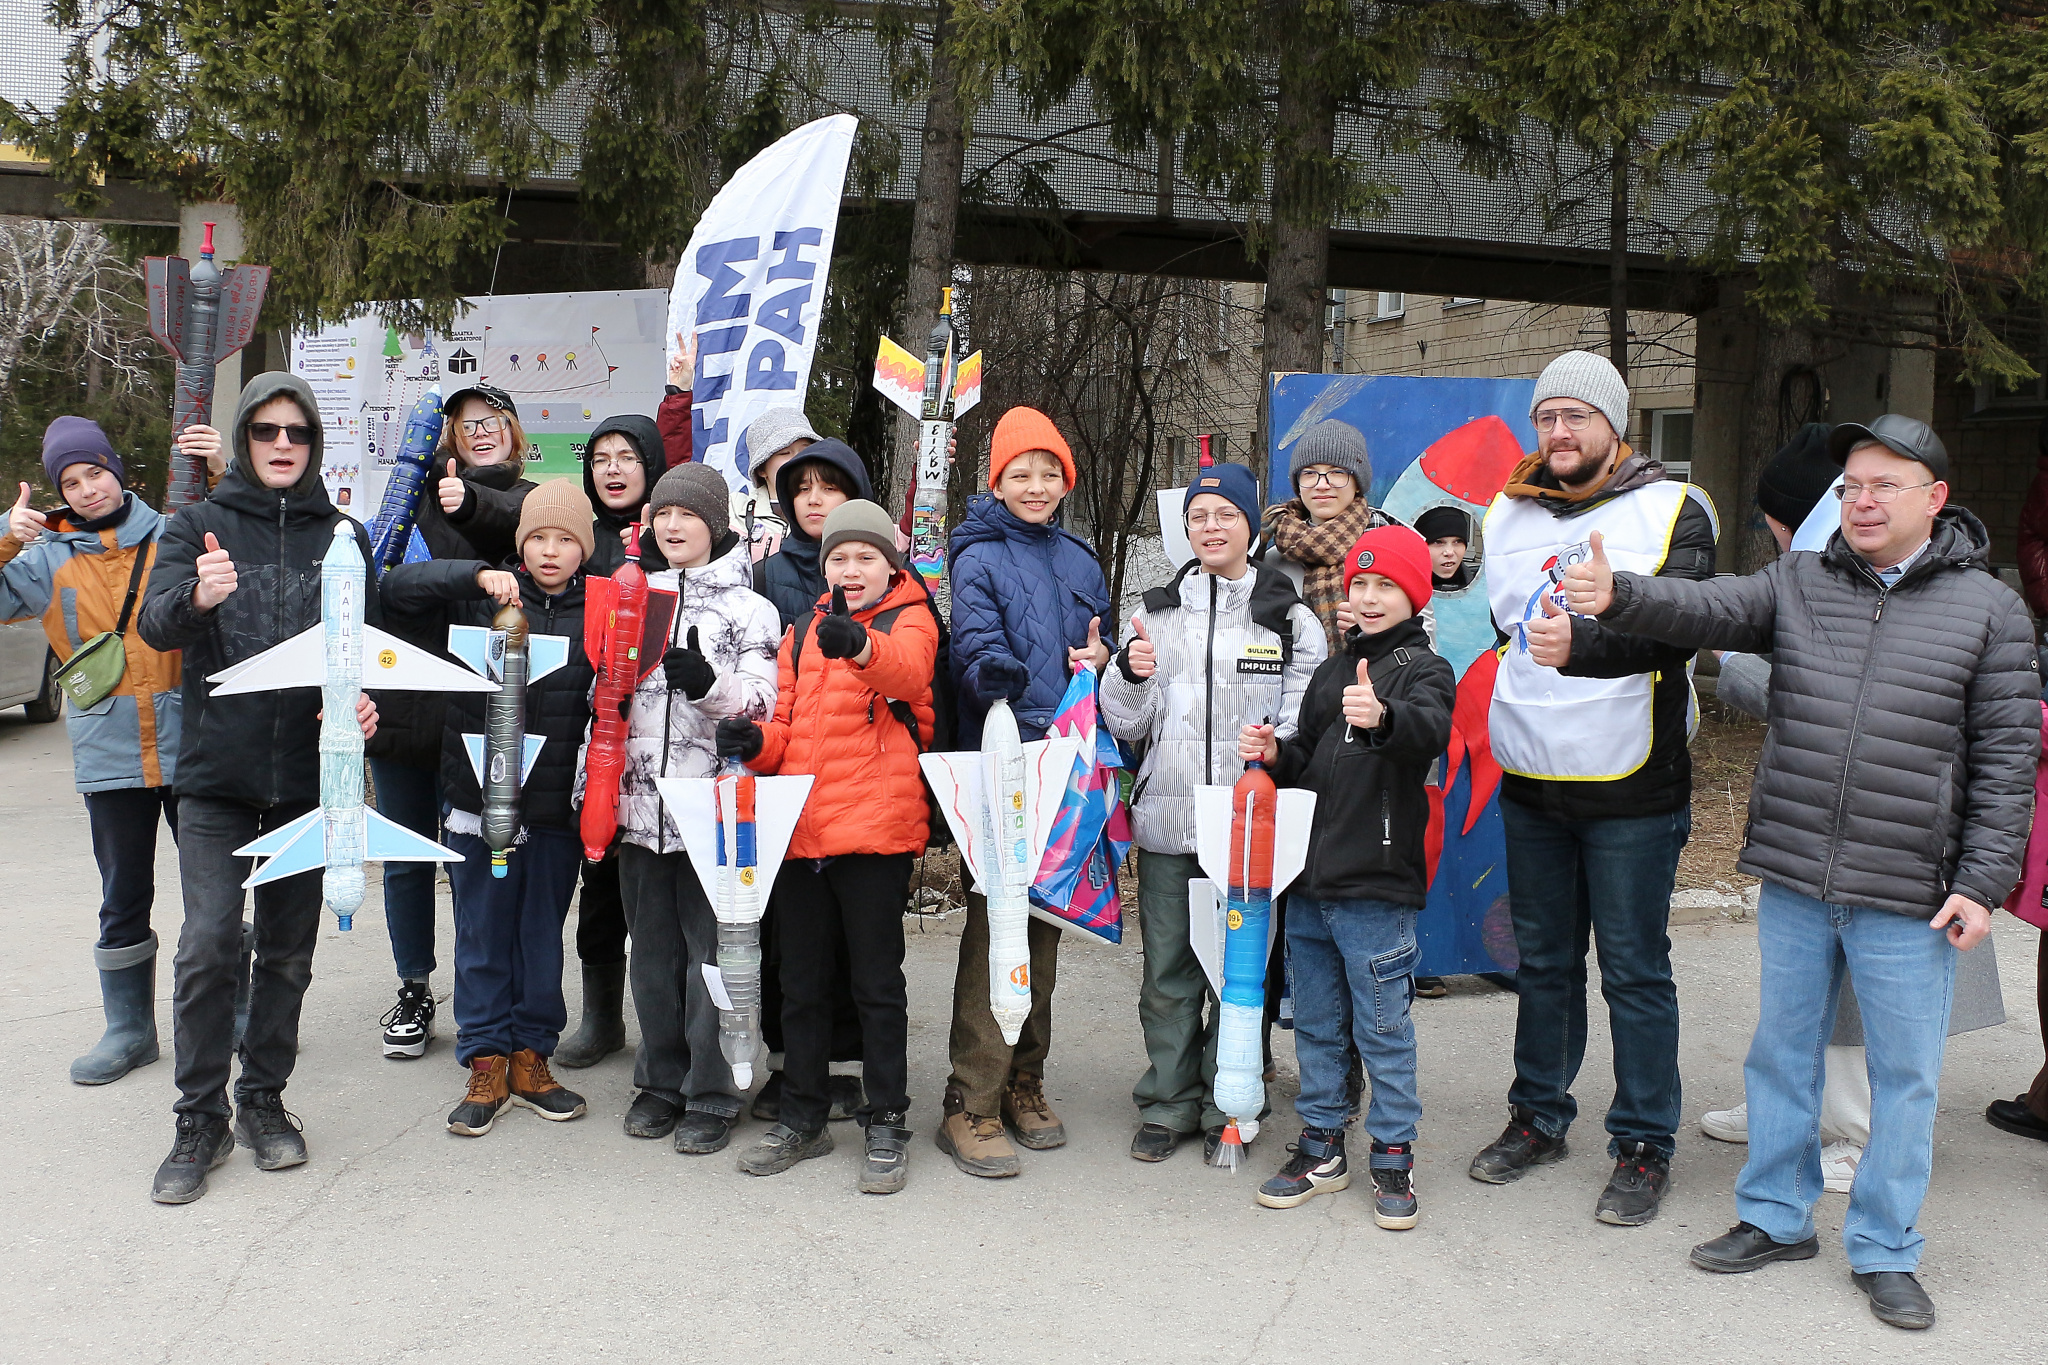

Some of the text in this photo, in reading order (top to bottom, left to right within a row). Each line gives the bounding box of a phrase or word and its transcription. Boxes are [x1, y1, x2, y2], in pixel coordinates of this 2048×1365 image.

[744, 227, 823, 391] РАН
[691, 236, 760, 475] ТПМ
[342, 581, 351, 667] ЛАНЦЕТ
[1247, 647, 1278, 655] GULLIVER
[381, 656, 393, 665] 42
[1240, 662, 1281, 672] IMPULSE
[744, 870, 753, 880] 39
